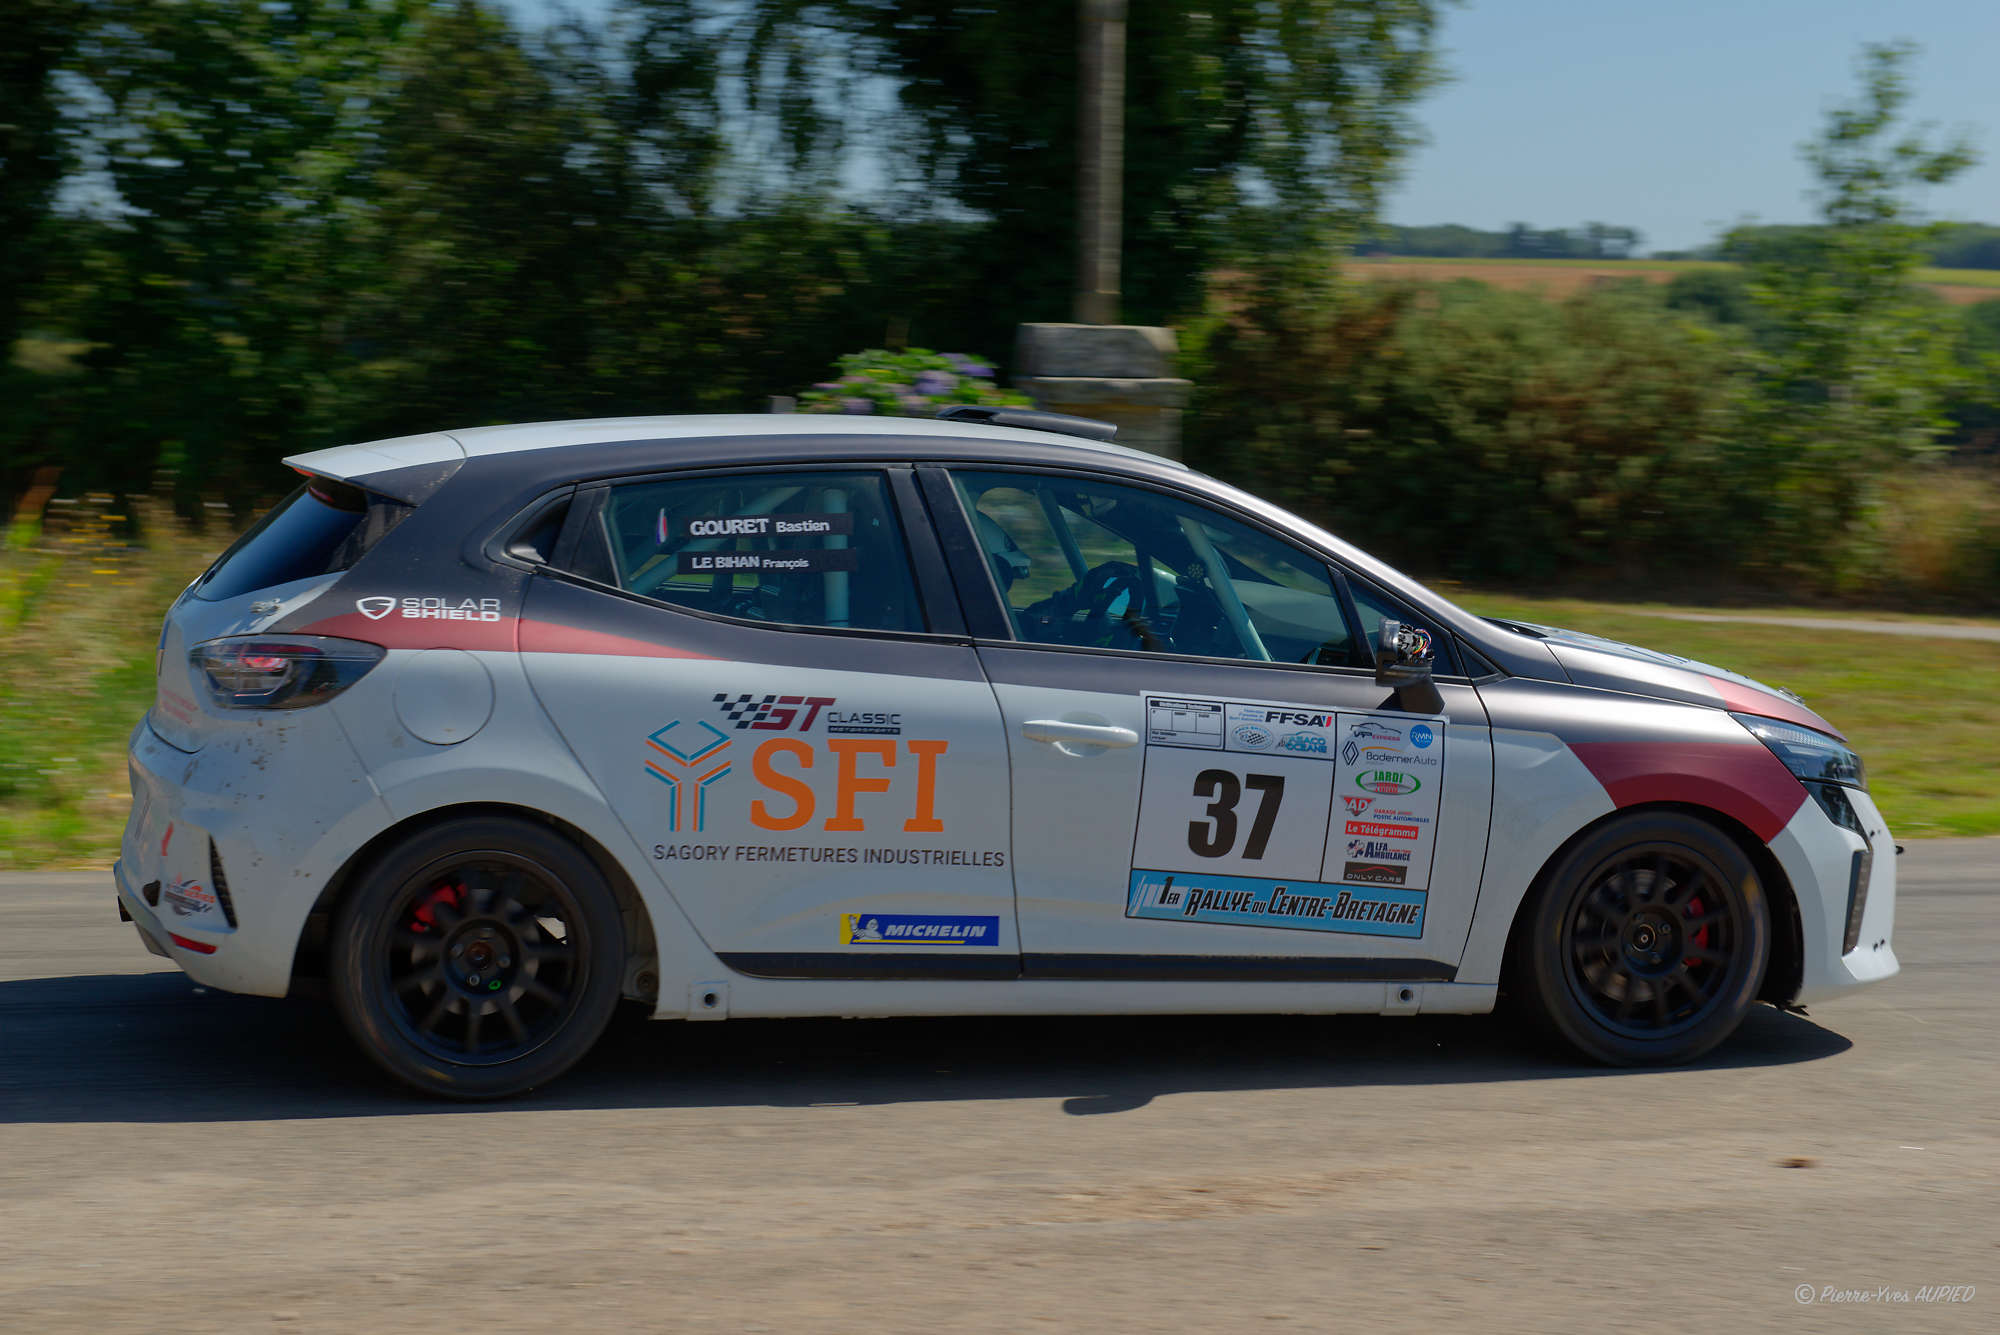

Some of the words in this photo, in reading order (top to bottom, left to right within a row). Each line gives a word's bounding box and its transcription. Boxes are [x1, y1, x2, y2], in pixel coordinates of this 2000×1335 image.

[690, 518, 769, 536] GOURET
[775, 519, 830, 533] Bastien
[692, 556, 713, 569] LE
[715, 556, 760, 569] BIHAN
[762, 557, 809, 570] François
[402, 597, 501, 611] SOLAR
[402, 609, 500, 622] SHIELD
[828, 712, 901, 725] CLASSIC
[1265, 711, 1325, 728] FFSA
[750, 737, 949, 832] SFI
[1346, 799, 1369, 810] AD
[1187, 768, 1285, 860] 37
[1347, 823, 1359, 833] Le
[1360, 824, 1416, 838] Télégramme
[653, 845, 730, 861] SAGORY
[735, 846, 858, 864] FERMETURES
[864, 848, 1005, 868] INDUSTRIELLES
[1346, 873, 1373, 881] ONLY
[1184, 888, 1254, 917] RALLYE
[1251, 901, 1267, 913] DU
[1267, 886, 1422, 925] CENTRE-BRETAGNE
[884, 924, 987, 939] MICHELIN
